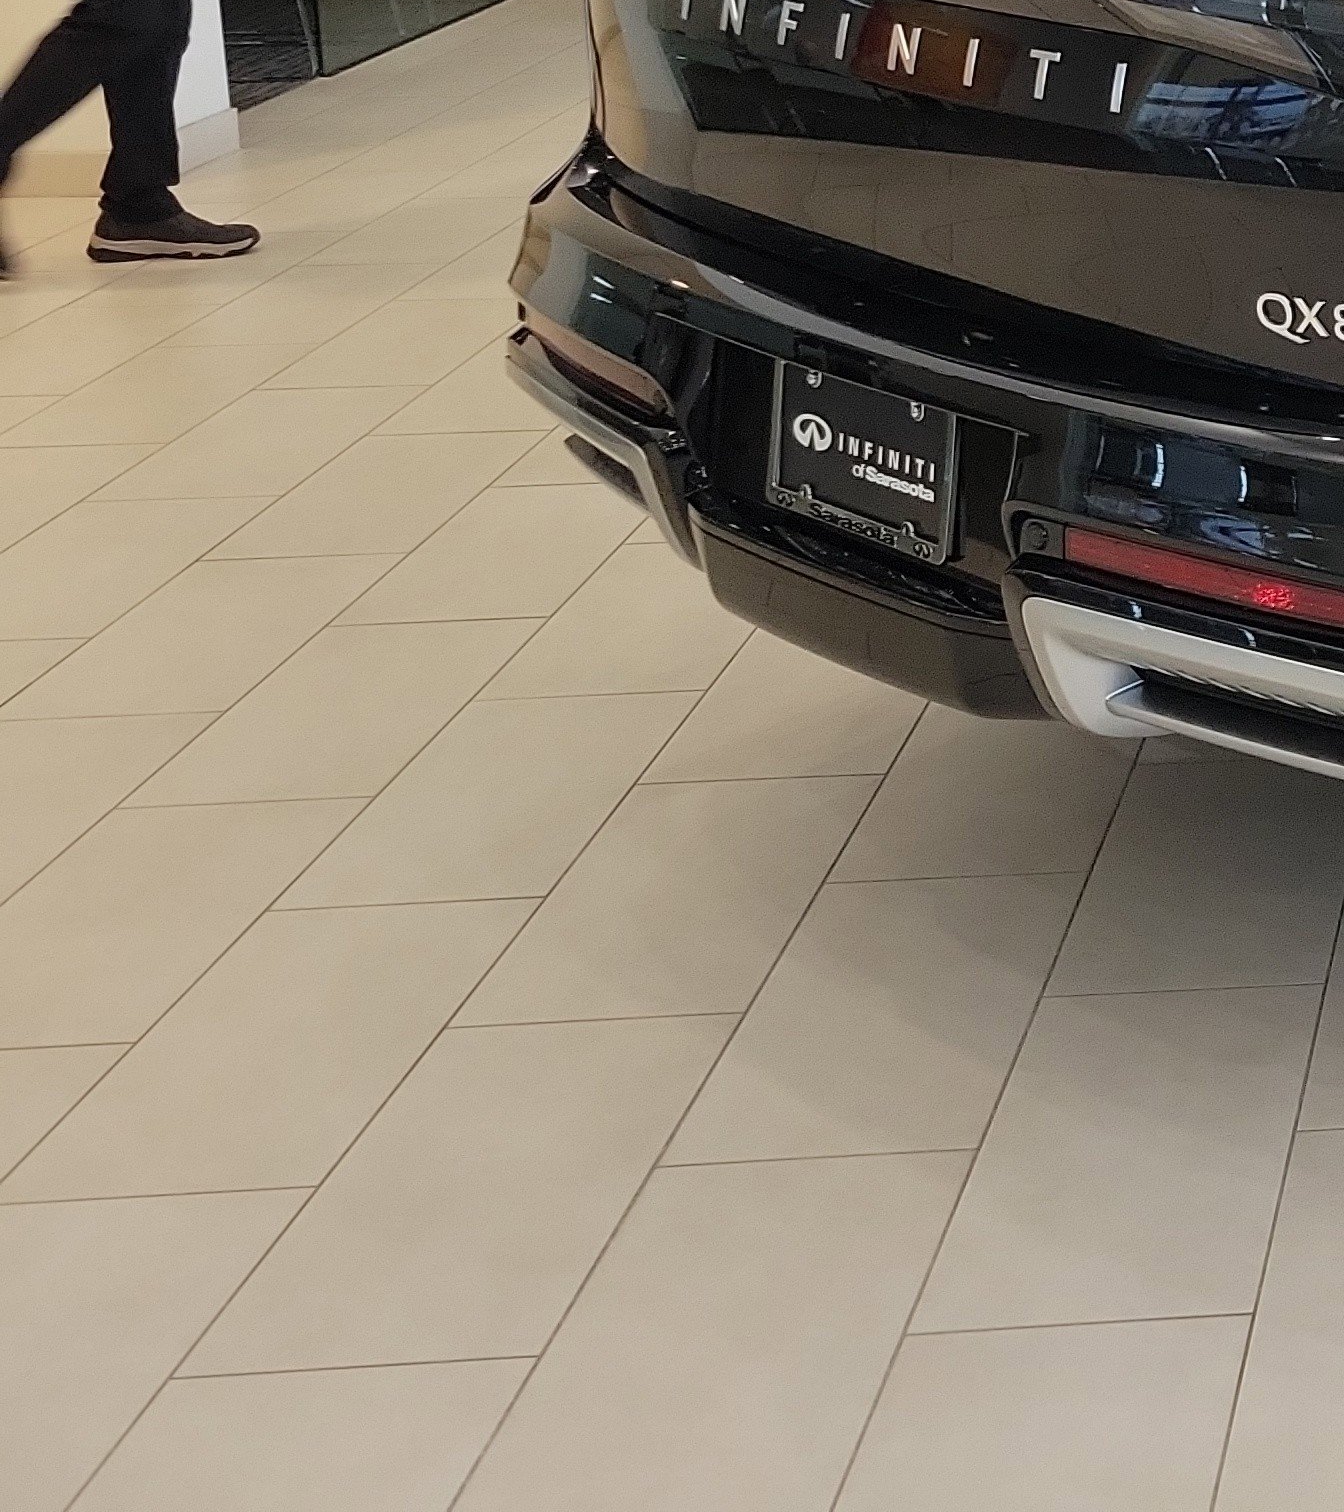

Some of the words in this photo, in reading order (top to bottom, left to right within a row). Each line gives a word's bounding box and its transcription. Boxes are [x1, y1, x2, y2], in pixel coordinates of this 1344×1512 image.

[837, 432, 936, 483] INFINITI
[852, 462, 867, 479] of
[865, 465, 936, 504] Sarasota
[808, 504, 897, 546] Sarasota
